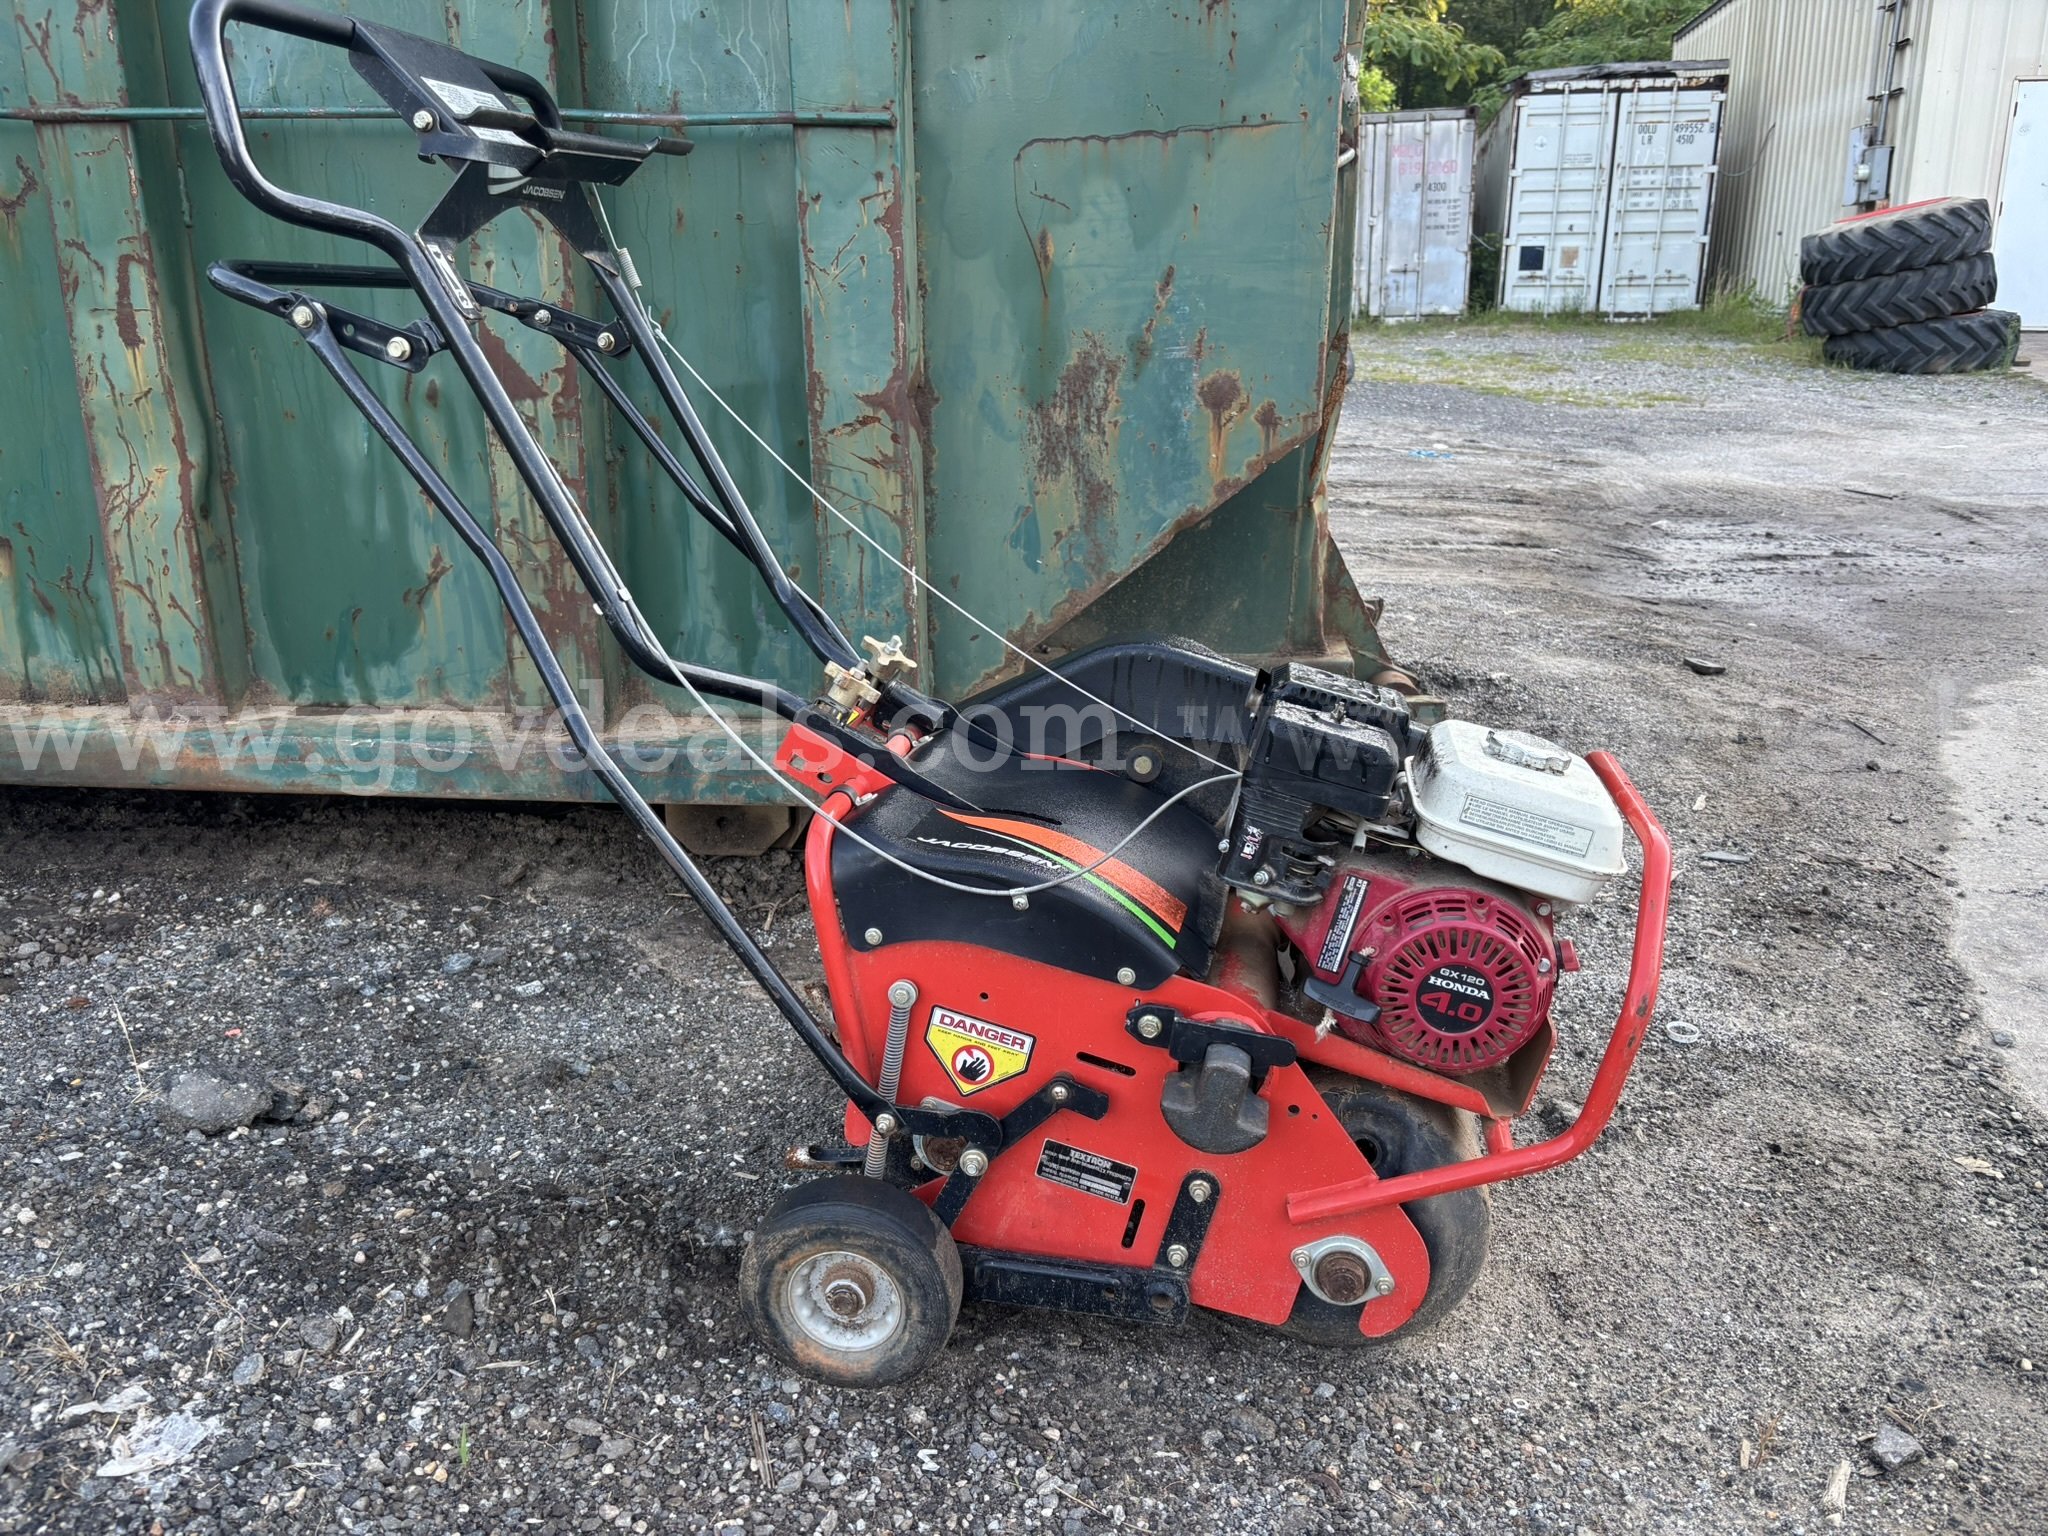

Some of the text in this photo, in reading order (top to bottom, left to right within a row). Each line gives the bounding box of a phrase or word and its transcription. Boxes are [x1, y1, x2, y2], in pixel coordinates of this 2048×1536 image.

[523, 185, 566, 199] JACOBSEN
[917, 836, 1061, 869] JACOBSEN
[1428, 975, 1490, 1000] HONDA
[1421, 991, 1483, 1022] 4.0
[939, 1013, 1026, 1050] DANGER
[1069, 1149, 1113, 1170] TEXTRON
